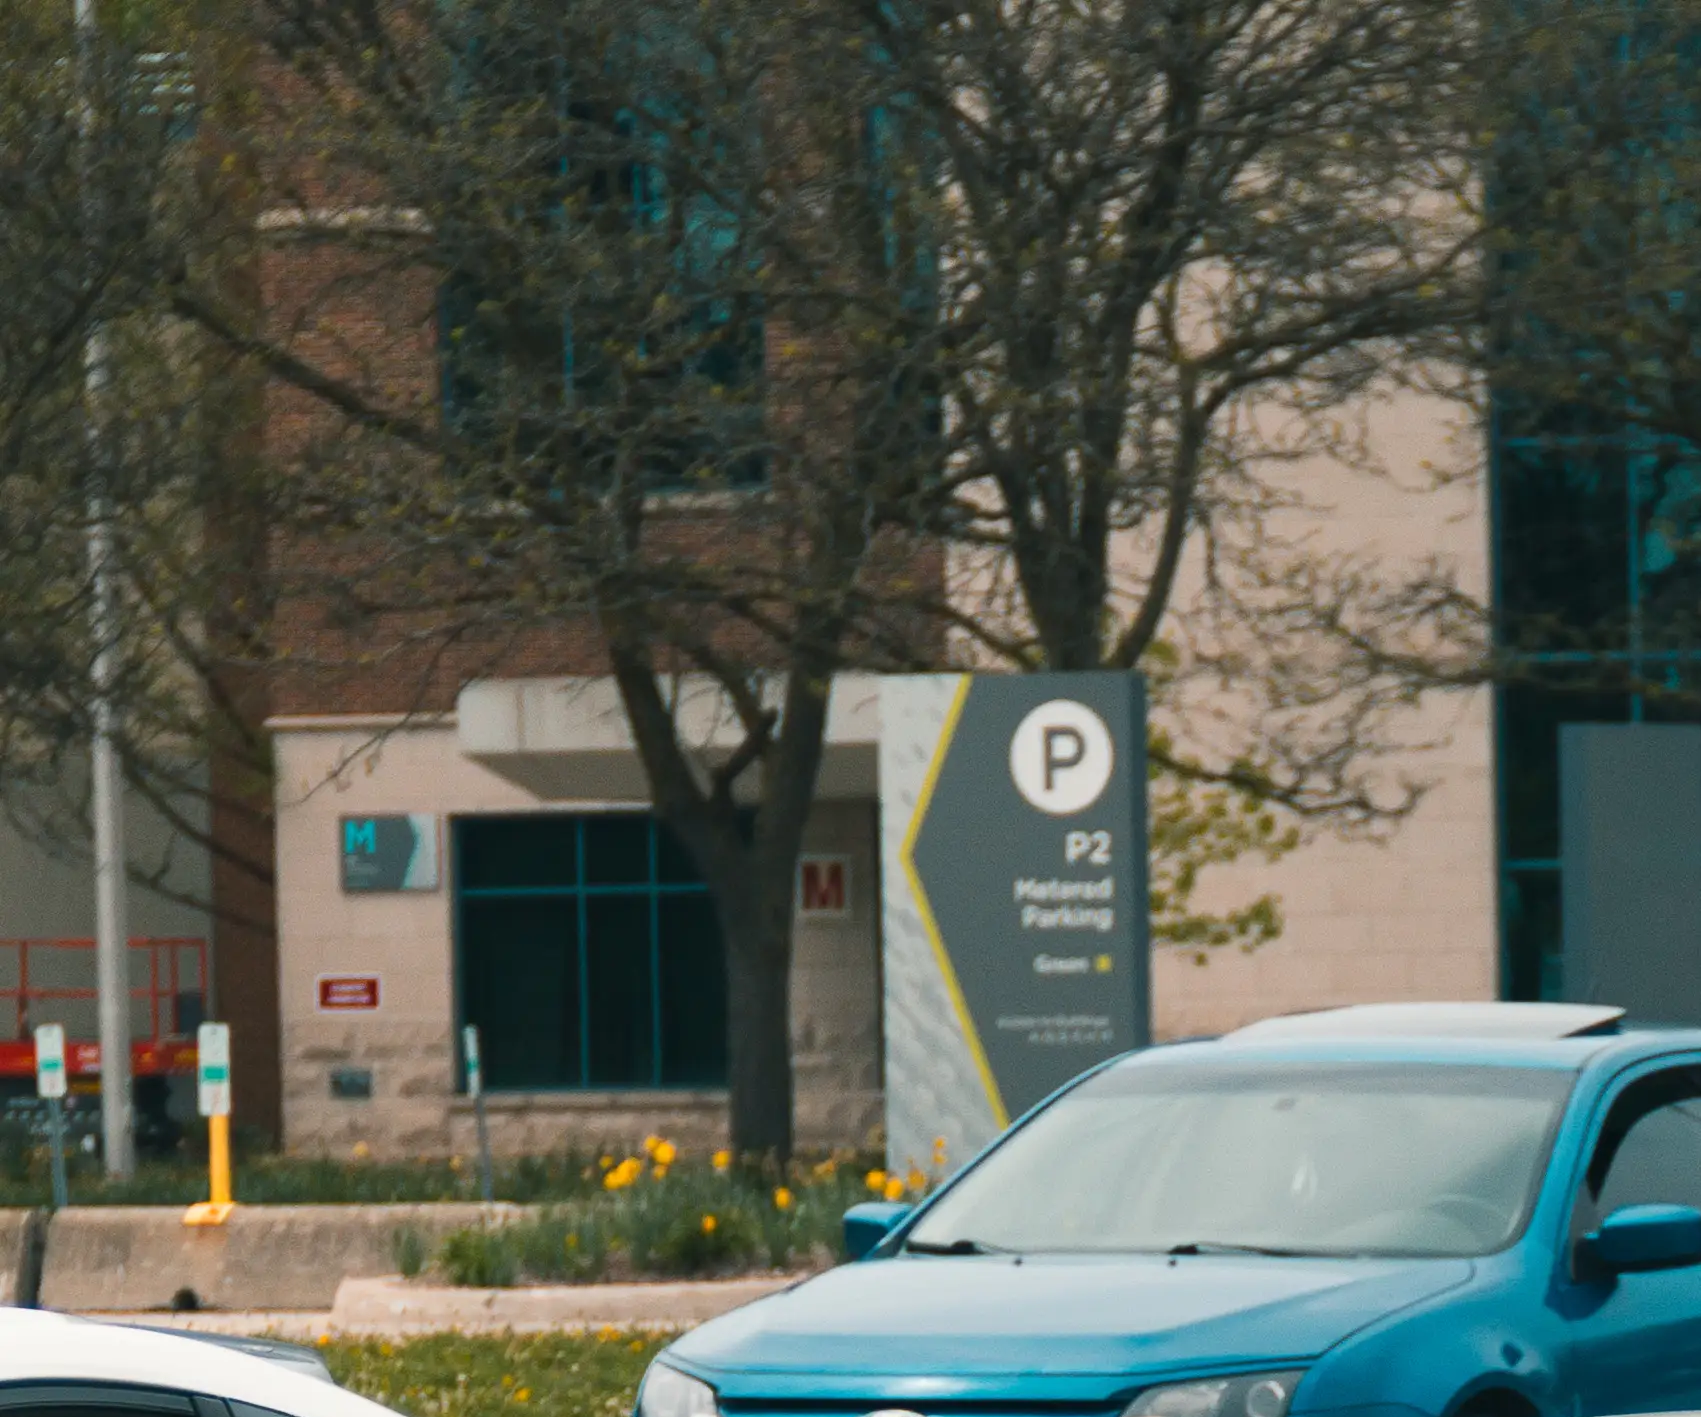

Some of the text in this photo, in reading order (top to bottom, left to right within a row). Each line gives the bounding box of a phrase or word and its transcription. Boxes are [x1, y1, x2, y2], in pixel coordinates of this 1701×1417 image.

[1043, 725, 1086, 790] P
[345, 819, 376, 853] M
[1065, 830, 1112, 864] P2
[1021, 904, 1114, 931] Parking
